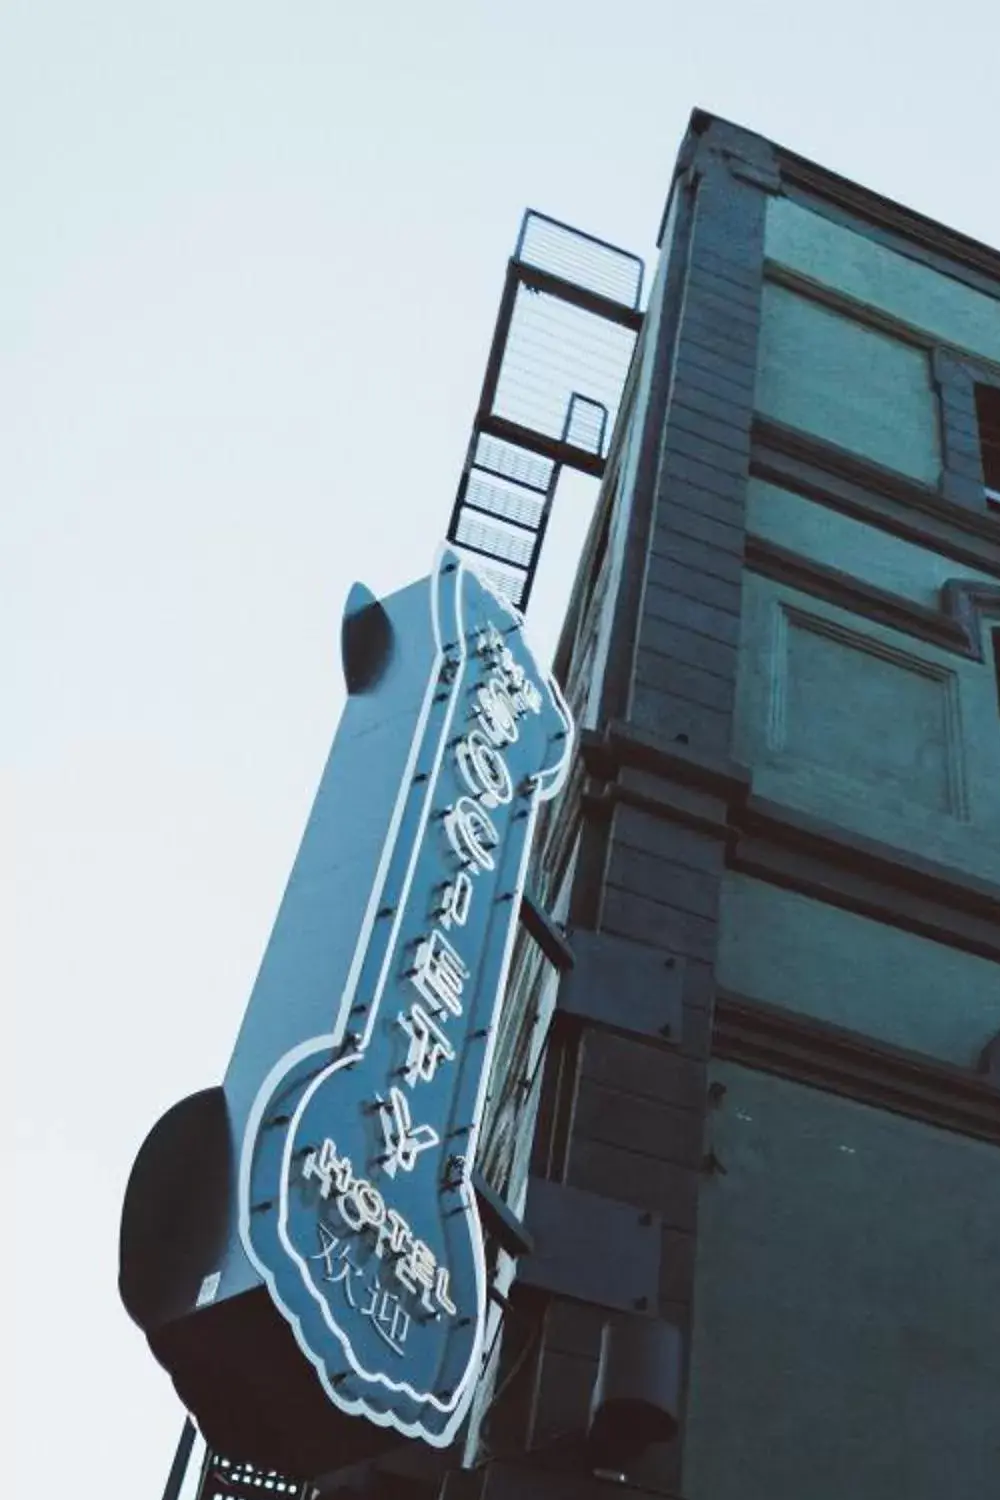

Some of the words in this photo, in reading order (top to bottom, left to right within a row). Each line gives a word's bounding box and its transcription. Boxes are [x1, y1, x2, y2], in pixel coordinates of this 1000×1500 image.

[376, 678, 519, 1178] SOCIETY
[302, 1138, 456, 1321] HOTEL
[310, 1221, 404, 1357] 欢迎
